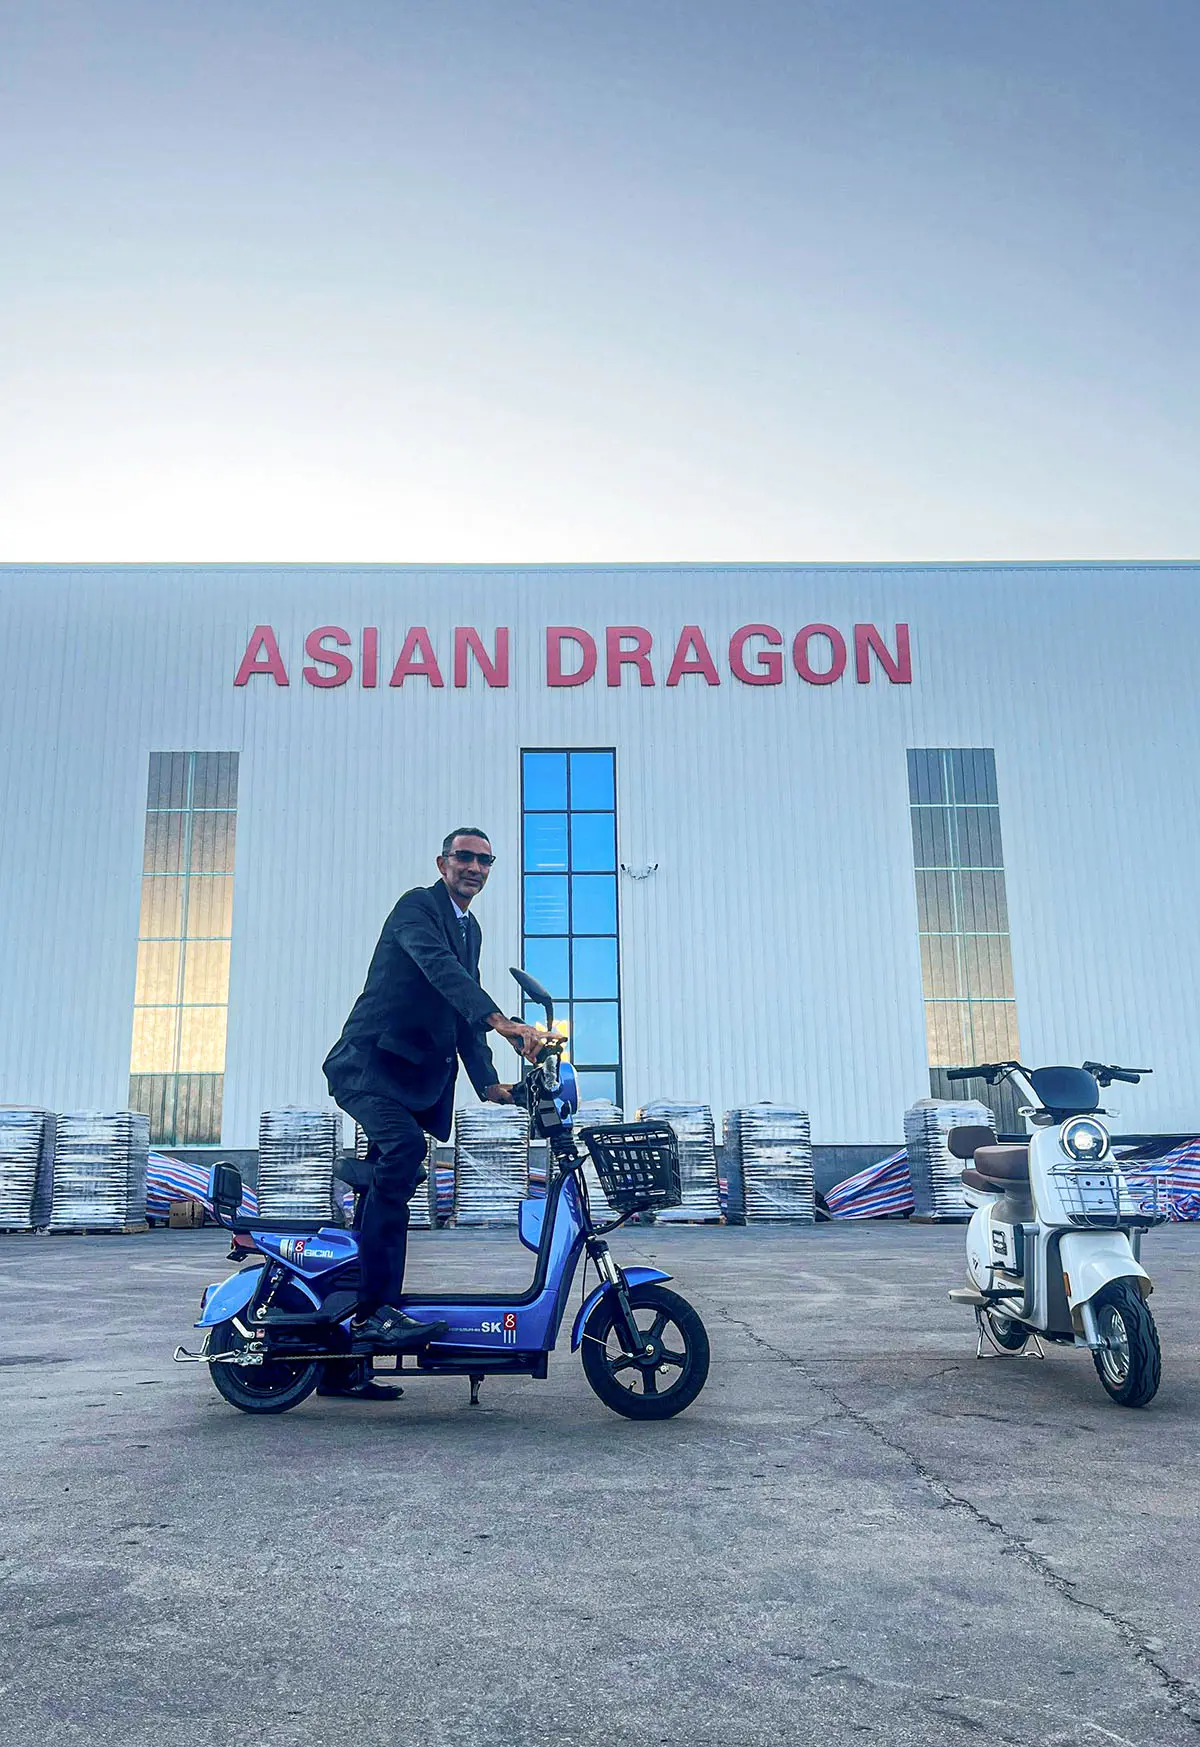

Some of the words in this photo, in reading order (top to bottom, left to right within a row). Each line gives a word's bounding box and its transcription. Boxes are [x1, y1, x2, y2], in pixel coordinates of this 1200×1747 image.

[233, 625, 508, 688] ASIAN
[546, 622, 912, 686] DRAGON
[481, 1321, 502, 1333] SK
[505, 1313, 515, 1328] 8
